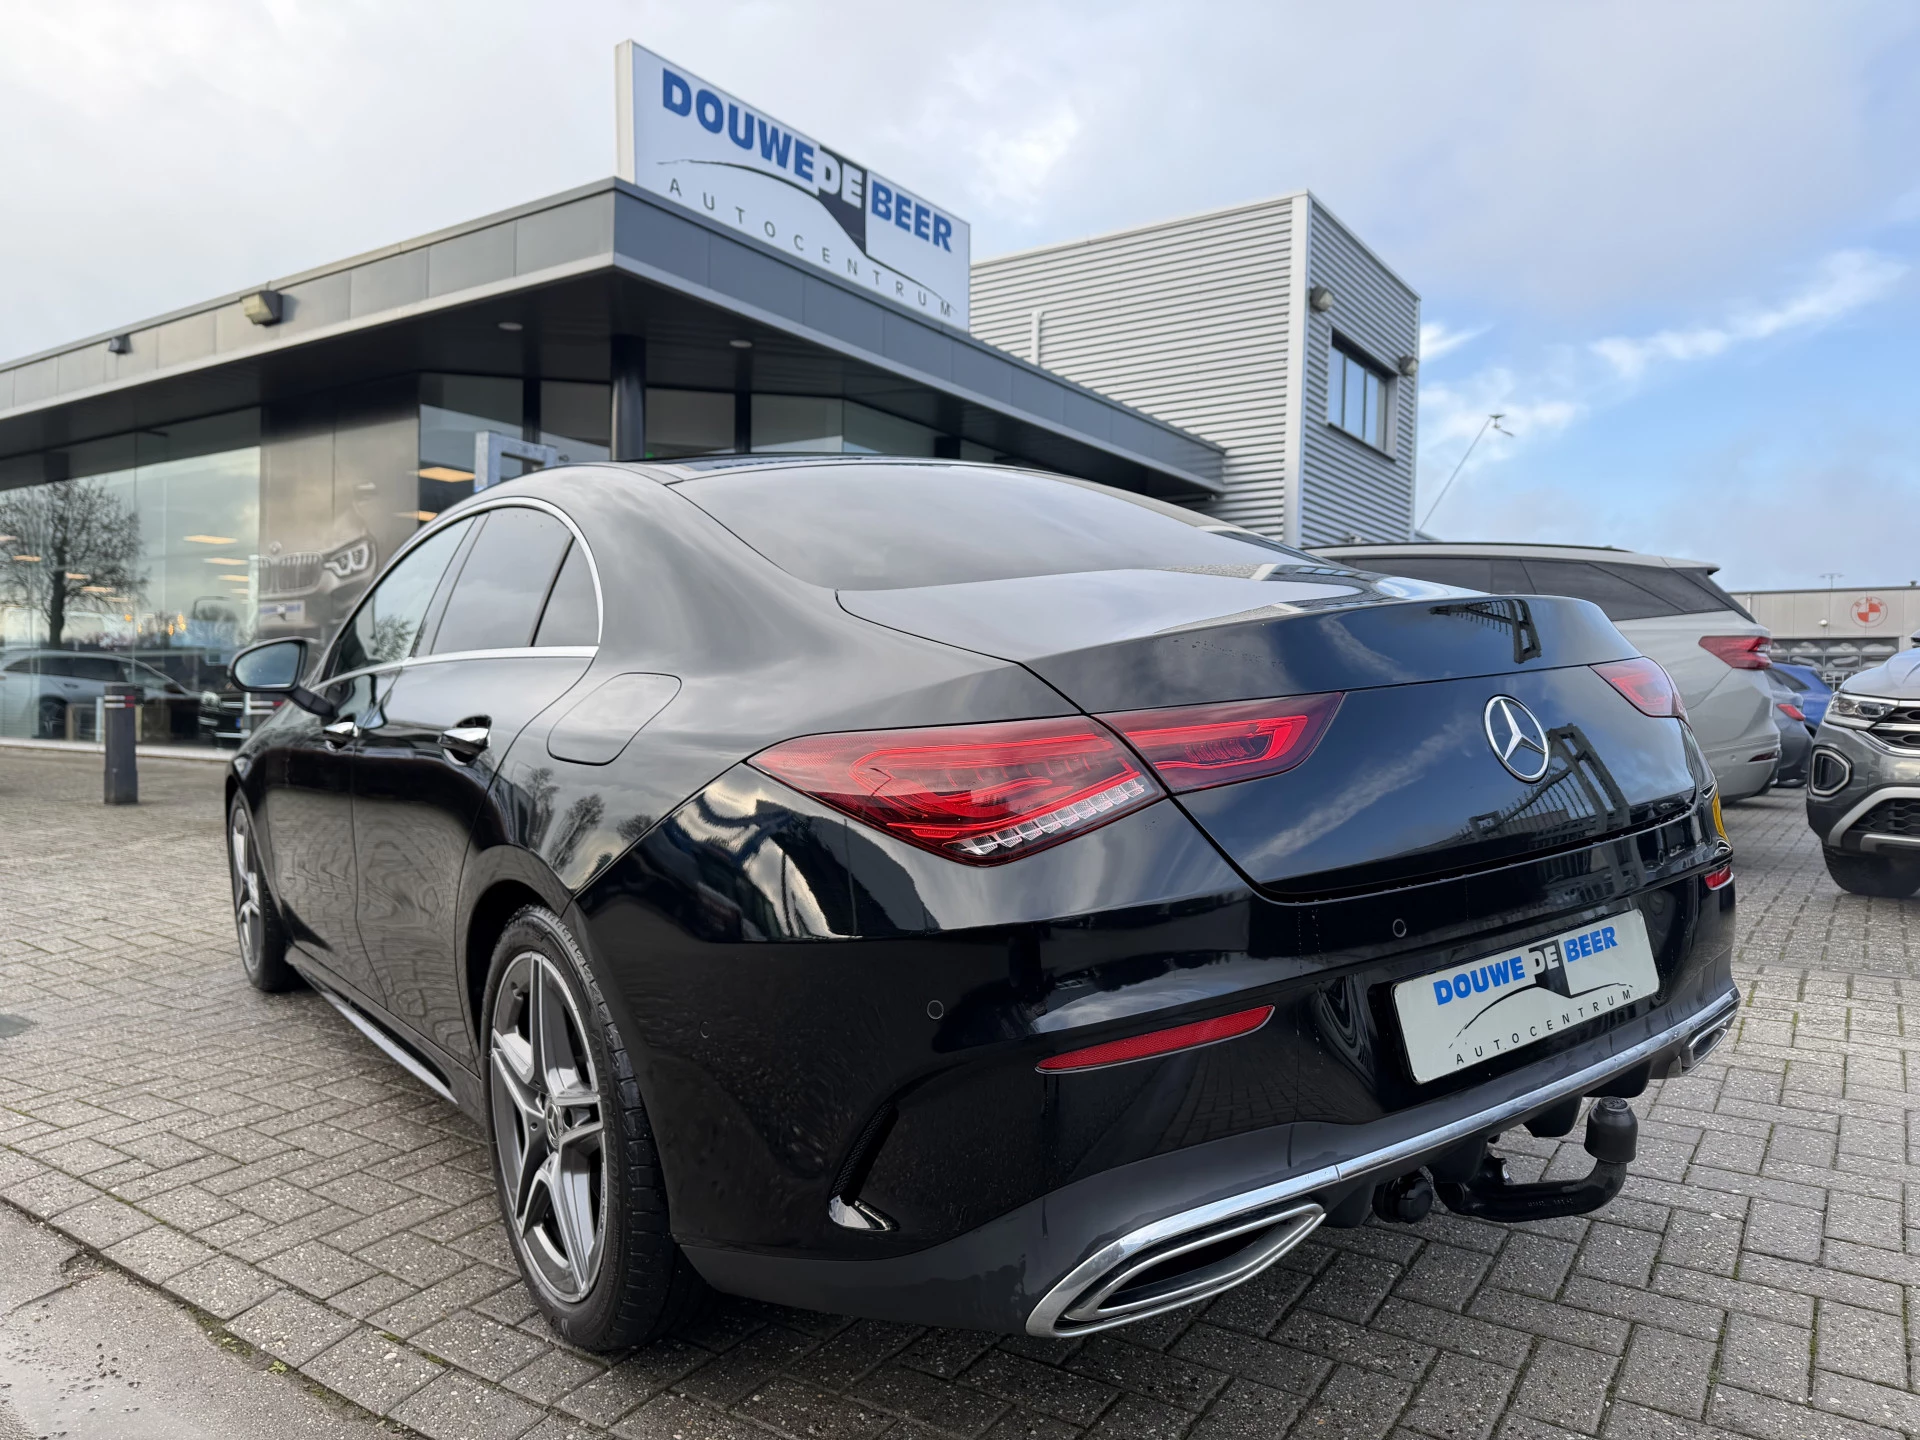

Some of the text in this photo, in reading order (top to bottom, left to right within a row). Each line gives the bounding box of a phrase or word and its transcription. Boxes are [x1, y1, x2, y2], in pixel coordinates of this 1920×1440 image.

[662, 67, 953, 253] DOUWE DE BEER
[669, 177, 951, 317] AUTOCENTRUM
[1433, 926, 1618, 1005] DOUWE DE BEER
[1456, 990, 1631, 1064] AUTOCENTRUM
